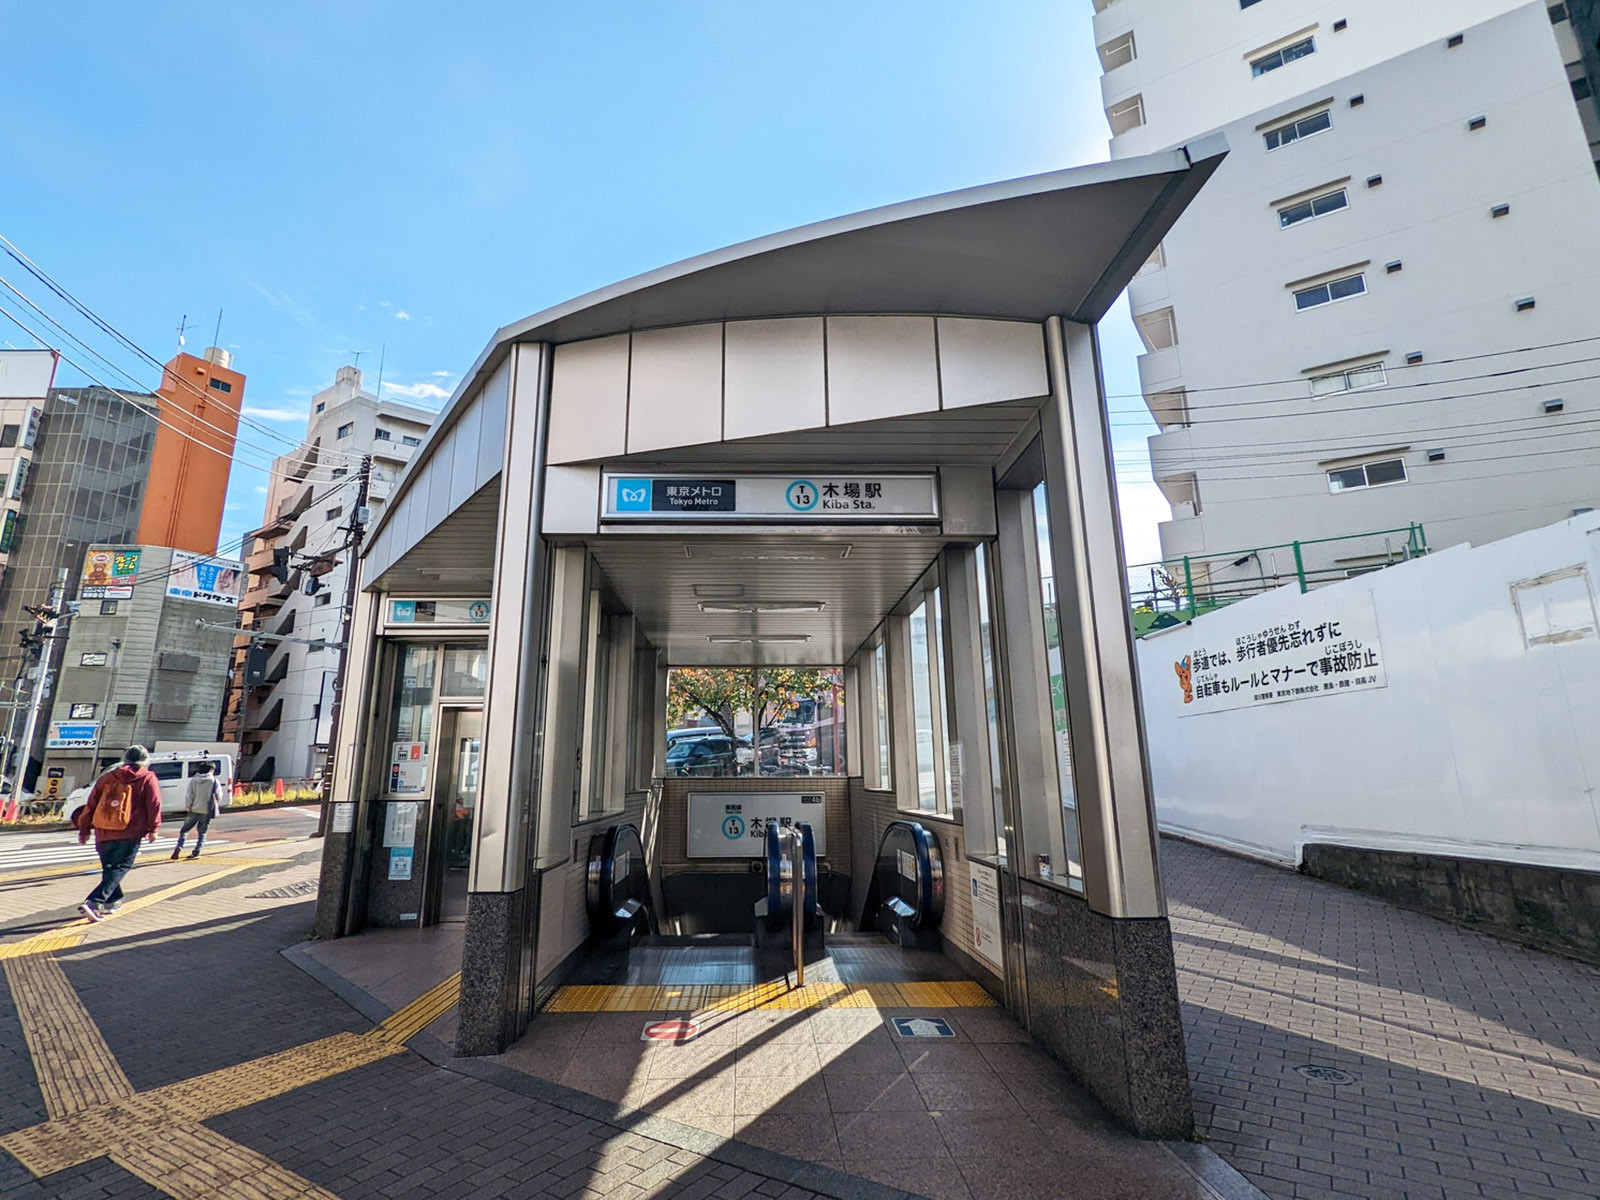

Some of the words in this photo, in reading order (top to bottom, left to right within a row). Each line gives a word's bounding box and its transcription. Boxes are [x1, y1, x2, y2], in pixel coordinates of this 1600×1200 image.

[666, 486, 722, 497] 東京メトロ
[799, 486, 806, 494] T
[822, 482, 882, 498] 木場駅
[670, 498, 693, 506] Tokyo
[796, 495, 810, 504] 13
[822, 500, 849, 510] Kiba
[853, 500, 876, 510] Sta.
[1196, 648, 1378, 700] 自転車もルールとマナーで事故防止
[750, 830, 767, 838] Kib
